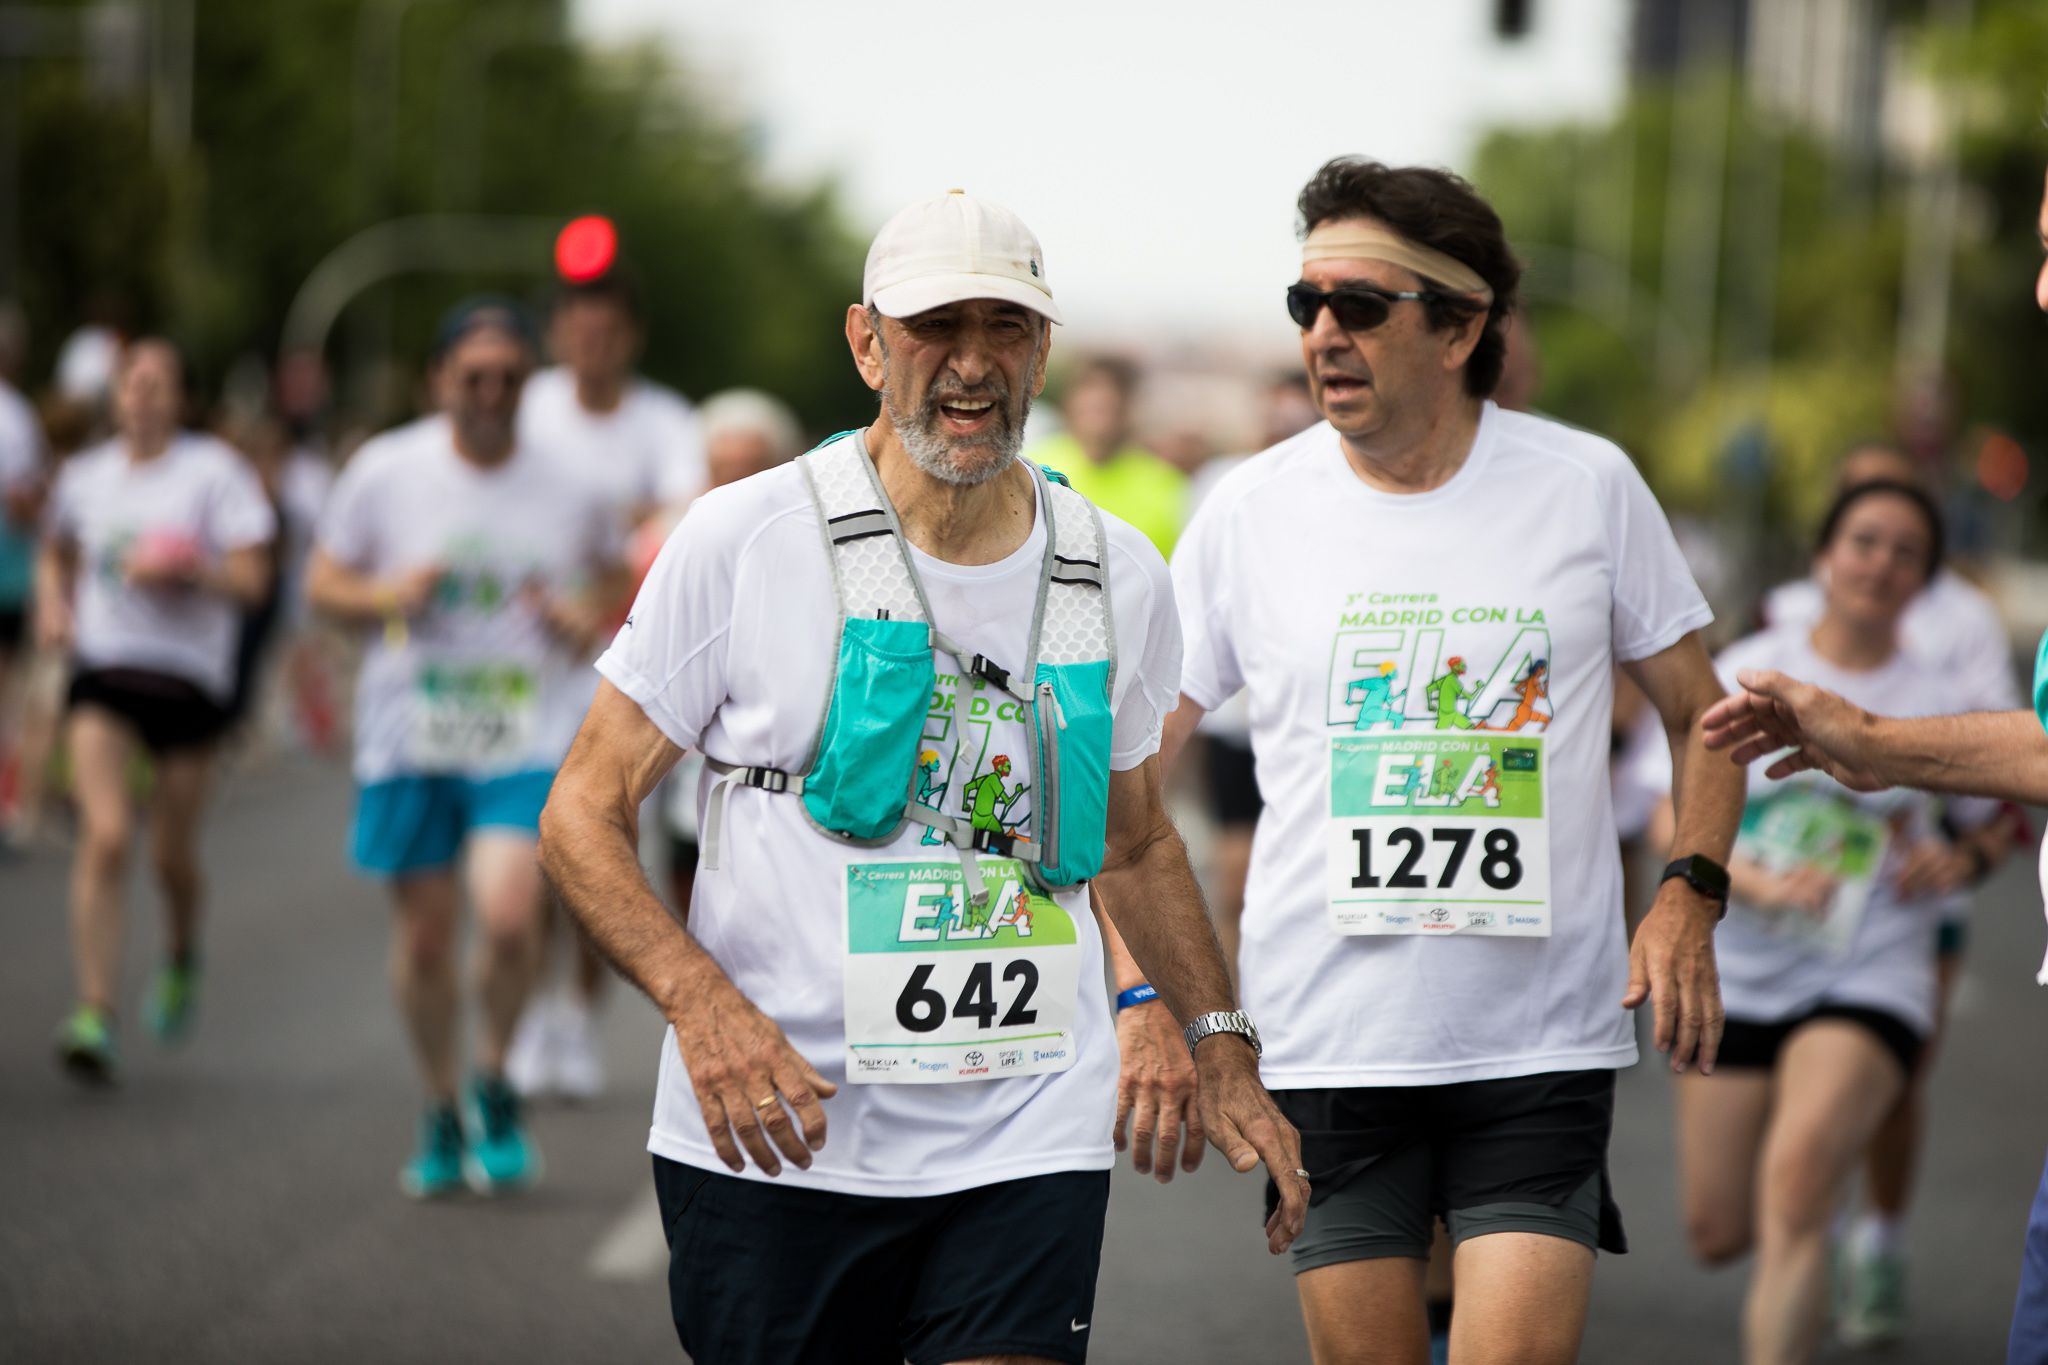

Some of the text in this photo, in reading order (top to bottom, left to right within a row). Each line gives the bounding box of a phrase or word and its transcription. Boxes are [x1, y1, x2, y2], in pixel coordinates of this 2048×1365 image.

[1367, 591, 1439, 606] Carrera
[1339, 607, 1547, 628] MADRID CON LA
[1327, 628, 1553, 727] ELA
[1380, 740, 1438, 753] MADRID
[1440, 740, 1471, 753] CON
[1472, 741, 1490, 753] LA
[1370, 753, 1501, 808] ELA
[1350, 826, 1524, 891] 1278
[867, 870, 905, 881] Carrera
[908, 868, 963, 881] MADRID
[1000, 865, 1017, 878] LA
[898, 880, 1033, 943] ELA
[895, 958, 1040, 1033] 642
[1001, 1057, 1016, 1067] LIFE
[1040, 1050, 1067, 1060] MADRID
